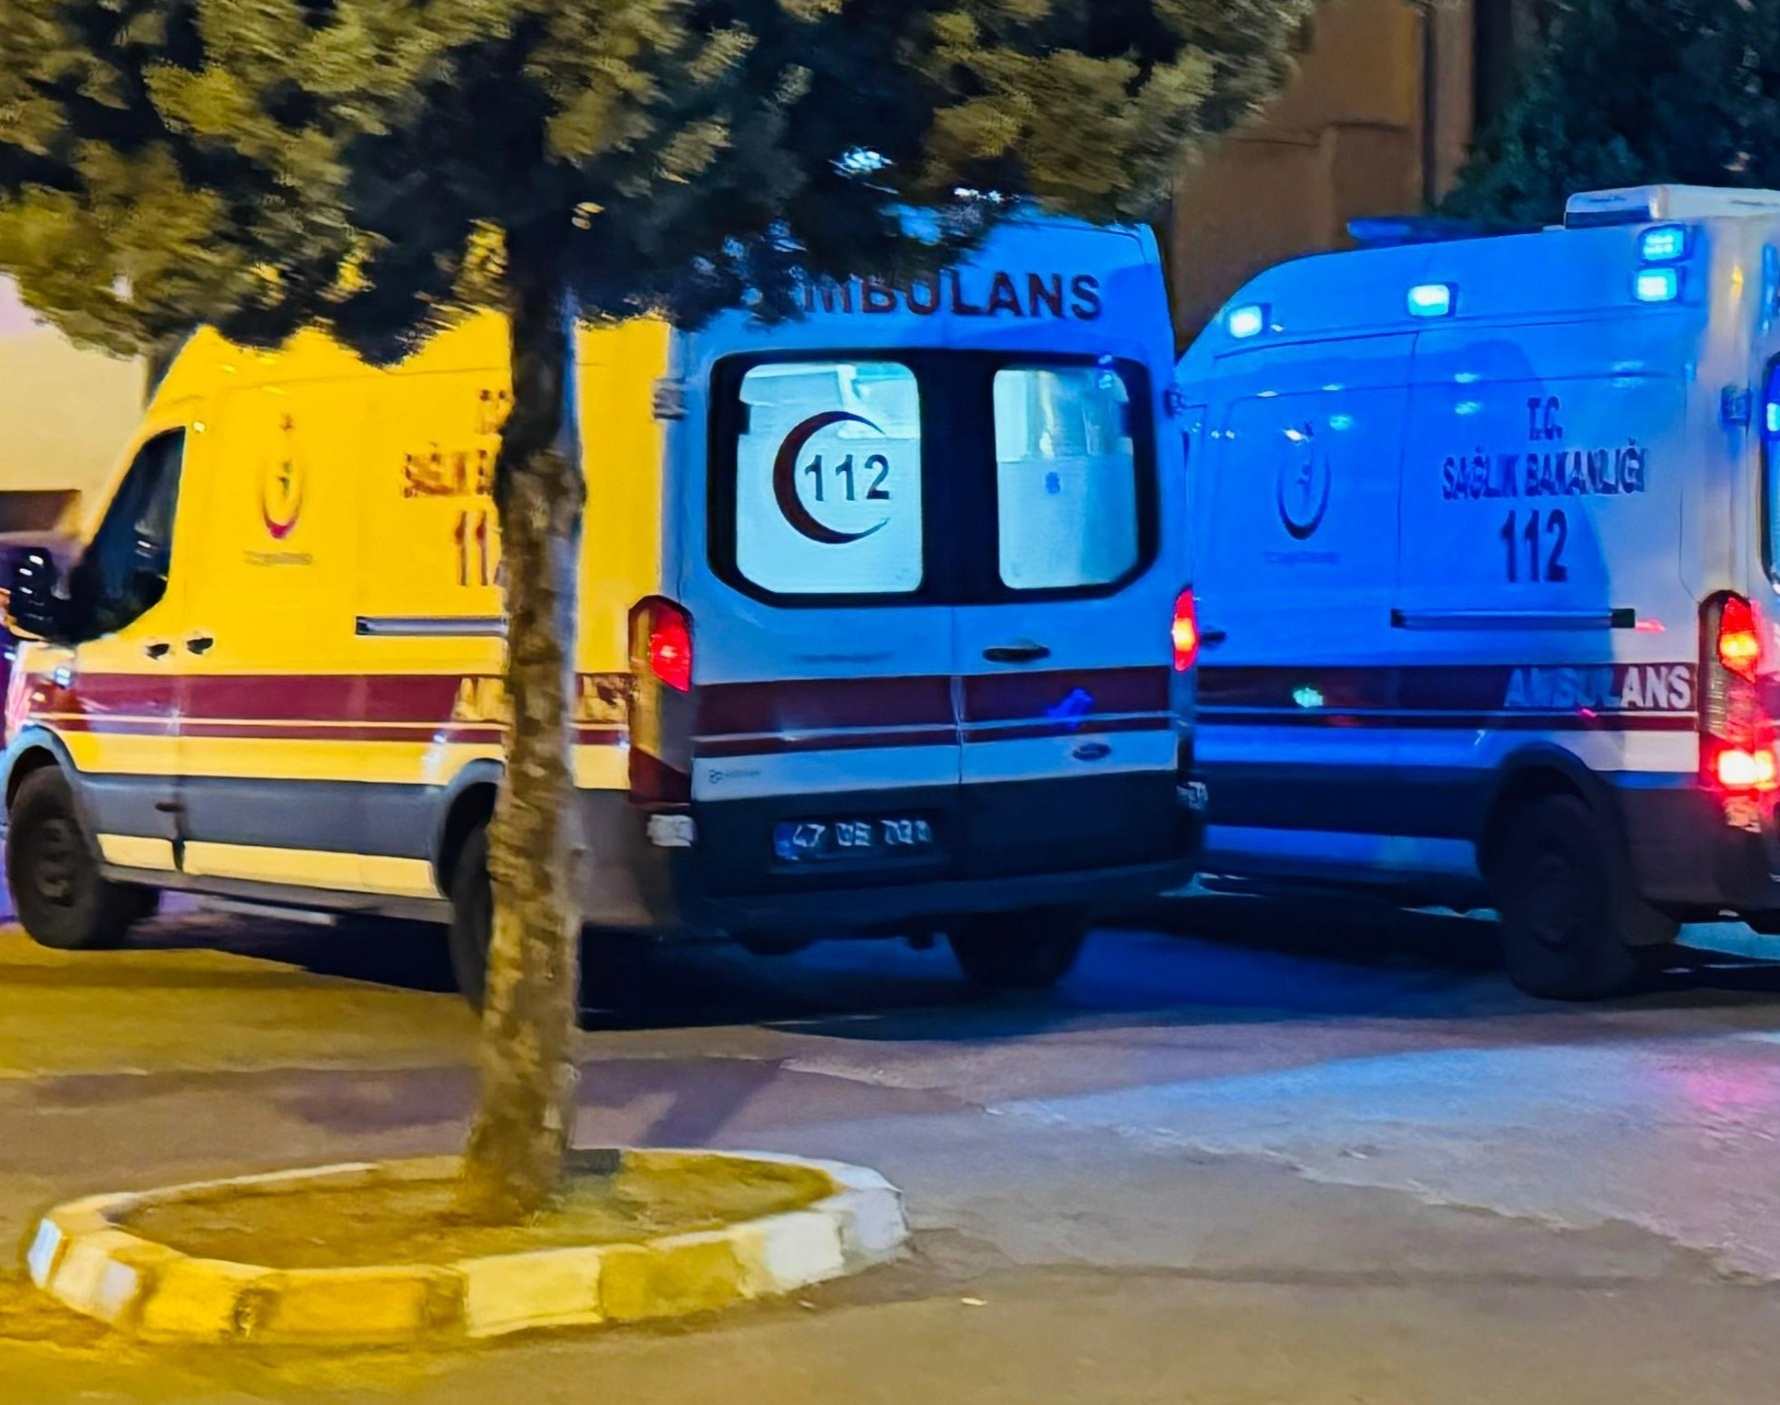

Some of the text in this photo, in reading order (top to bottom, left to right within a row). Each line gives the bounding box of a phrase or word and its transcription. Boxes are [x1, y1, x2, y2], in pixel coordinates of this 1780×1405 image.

[803, 267, 1101, 321] MBULANS
[804, 455, 891, 502] 112
[454, 510, 504, 586] 11
[1501, 508, 1569, 584] 112
[1504, 665, 1692, 709] AMBULANS
